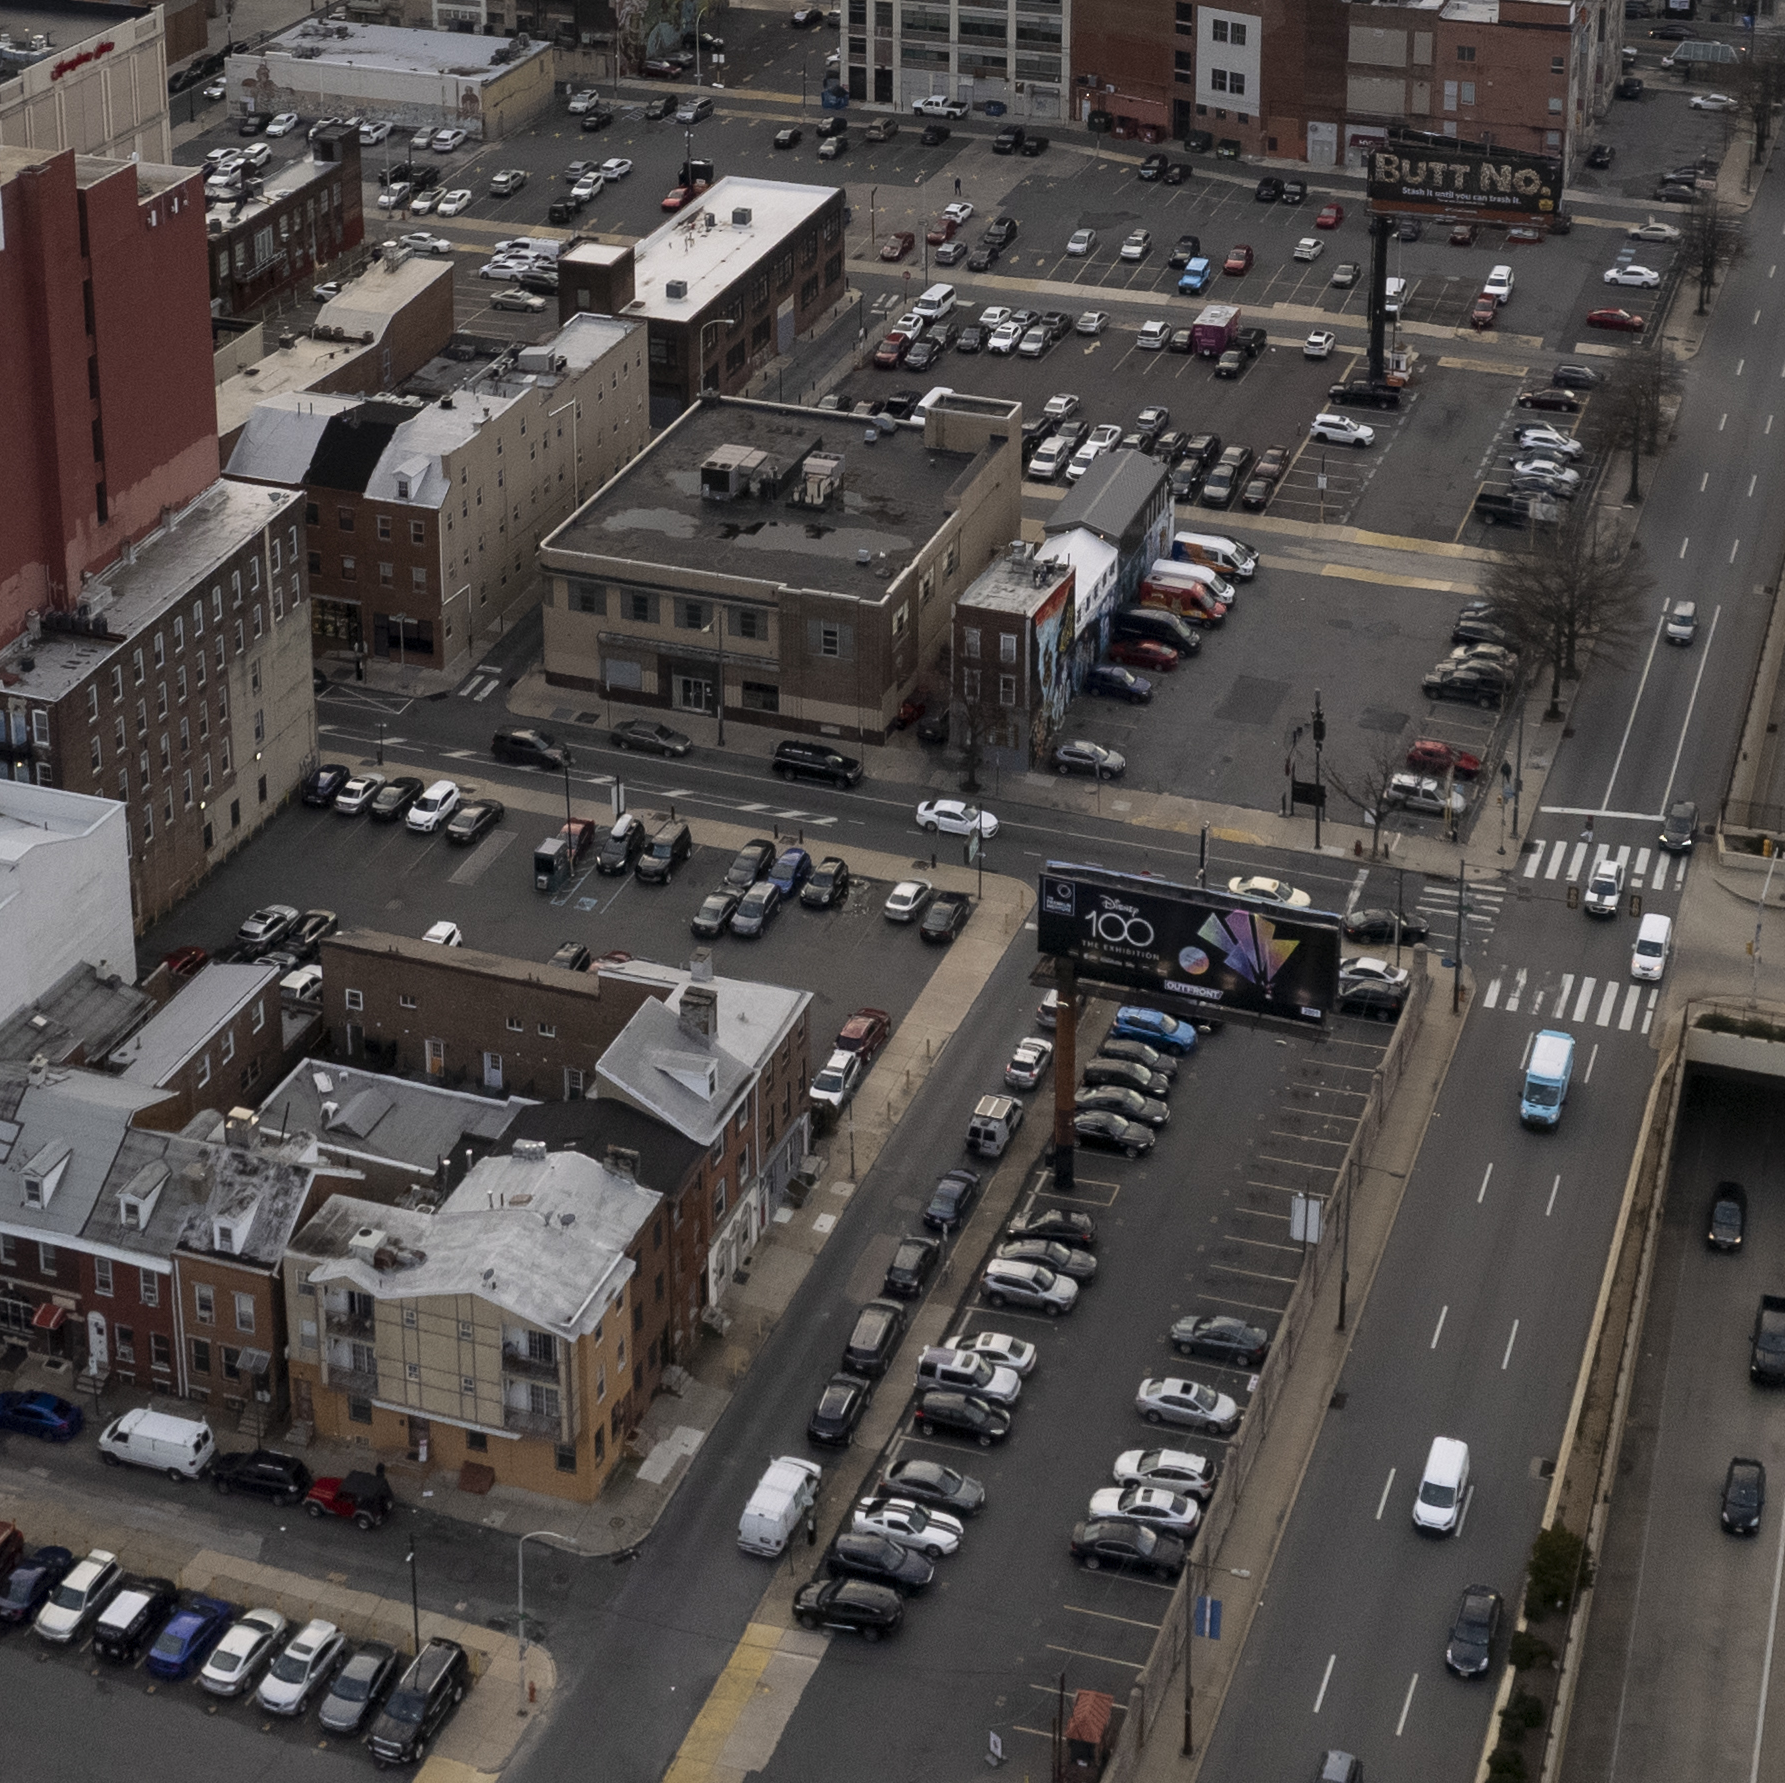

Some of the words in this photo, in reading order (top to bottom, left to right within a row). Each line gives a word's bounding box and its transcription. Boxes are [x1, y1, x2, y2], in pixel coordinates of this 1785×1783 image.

[1374, 152, 1471, 191] BUTT
[1402, 186, 1425, 197] Stash
[1426, 189, 1433, 197] it
[1435, 190, 1454, 199] until
[1455, 192, 1471, 202] you
[1473, 194, 1488, 202] can
[1489, 194, 1511, 204] trash
[1512, 196, 1522, 205] it.
[1099, 894, 1141, 918] Disney
[1084, 910, 1155, 948] 100
[1082, 939, 1100, 950] THE
[1103, 943, 1160, 961] EXHIBITION
[1165, 981, 1220, 999] OUTFRONT
